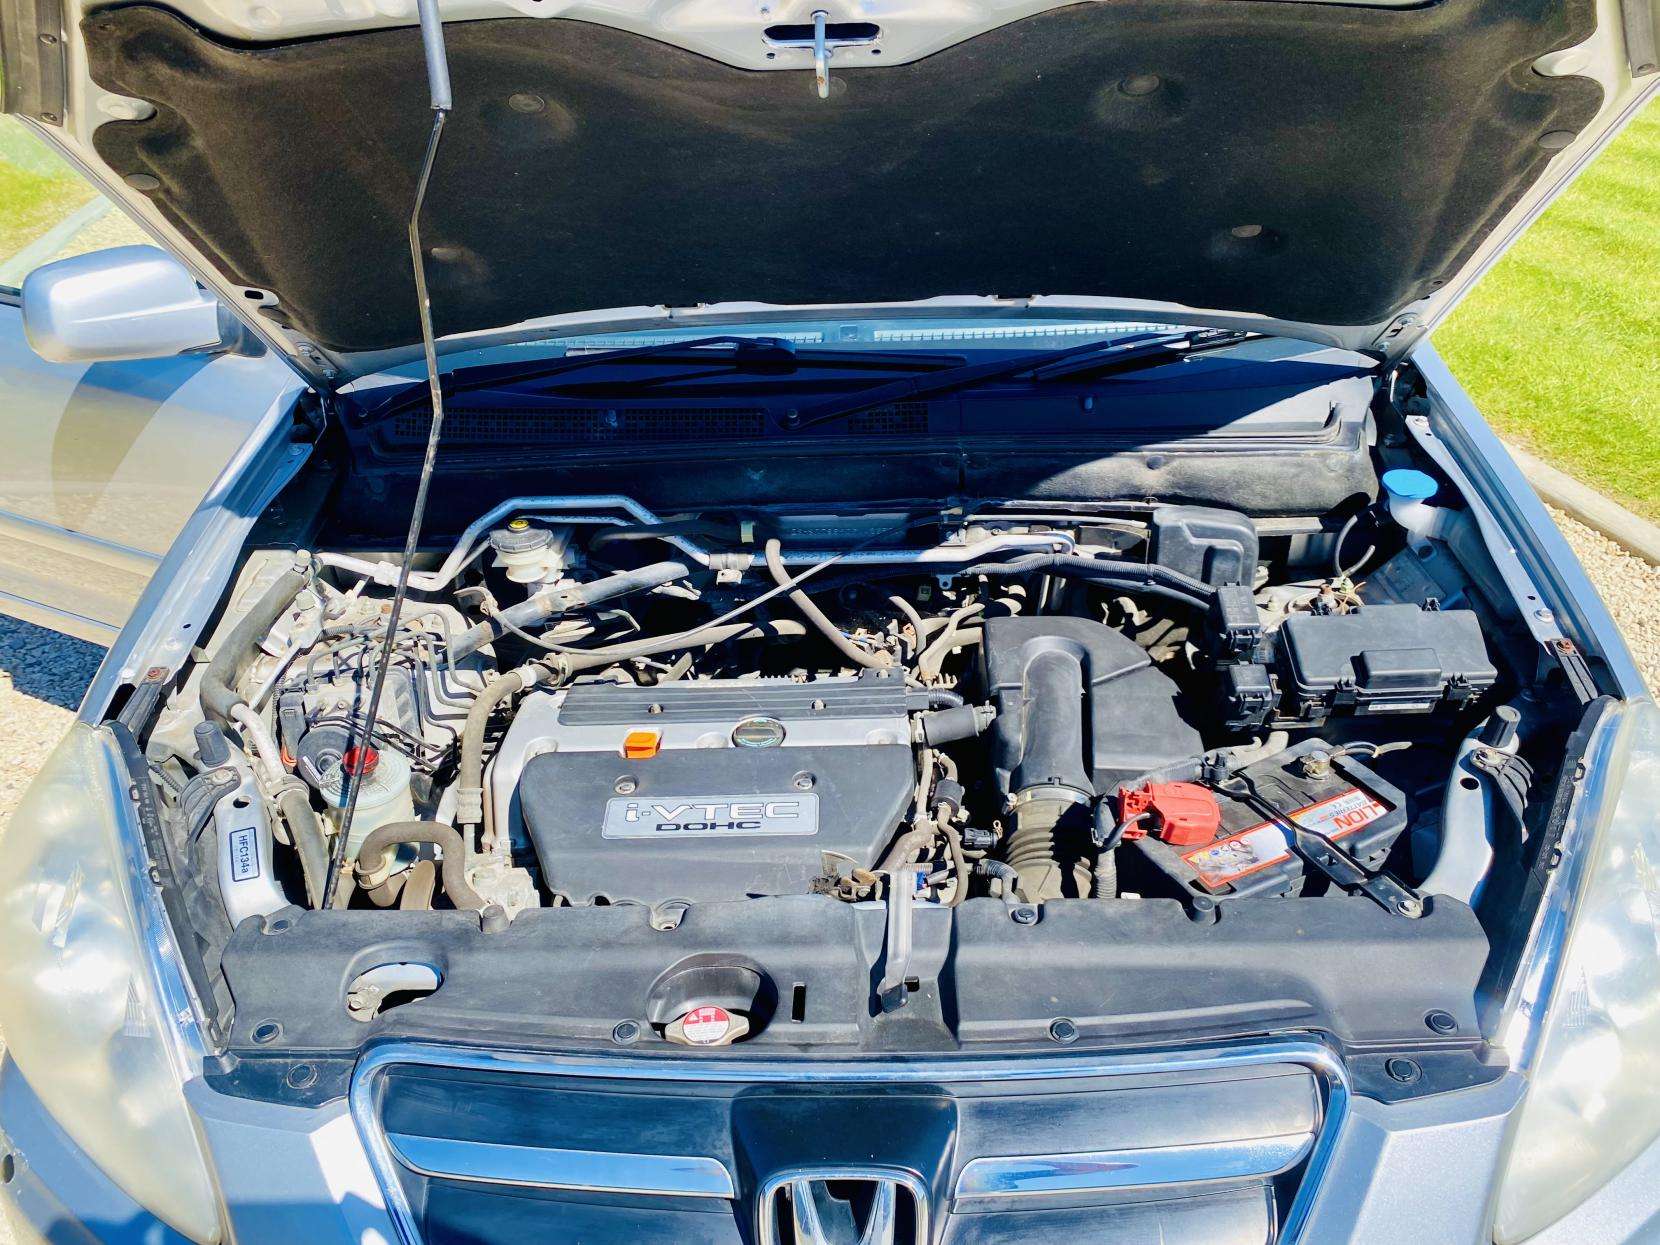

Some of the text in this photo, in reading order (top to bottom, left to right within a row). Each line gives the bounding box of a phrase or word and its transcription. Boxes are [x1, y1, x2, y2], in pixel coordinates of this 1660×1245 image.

[625, 801, 799, 822] i-VTEC
[1333, 805, 1378, 829] LION
[656, 821, 761, 832] DOHC
[238, 834, 250, 874] HFC134a
